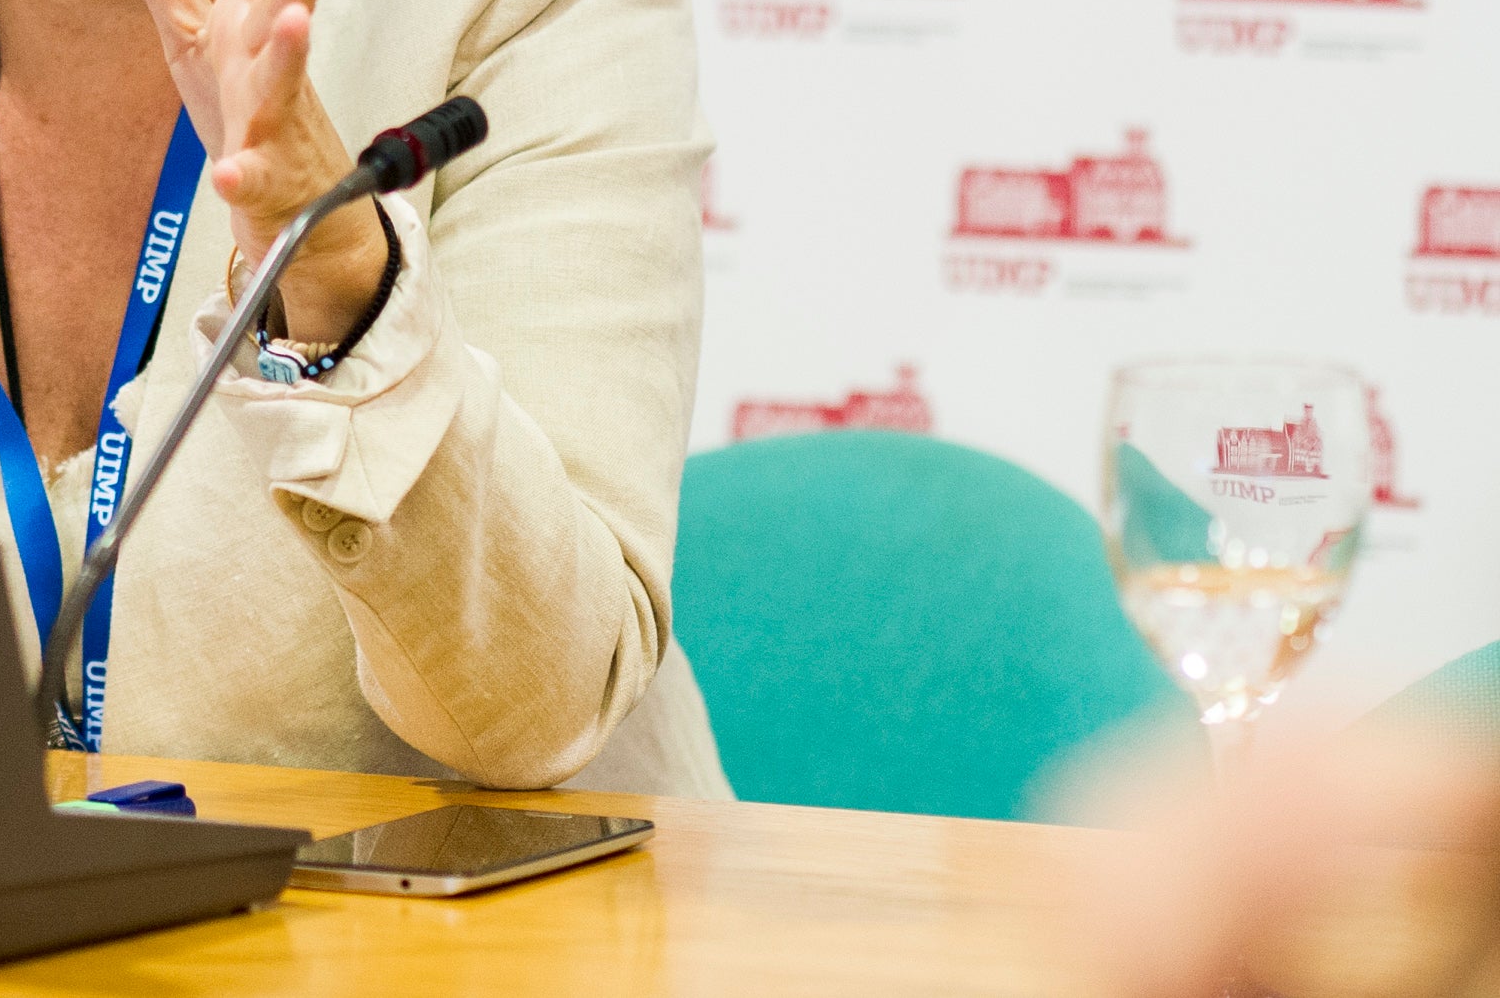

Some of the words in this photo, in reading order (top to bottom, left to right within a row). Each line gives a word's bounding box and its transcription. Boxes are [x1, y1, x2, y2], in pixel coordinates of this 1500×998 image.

[136, 208, 184, 304] UIMP
[91, 430, 128, 527] UIMP
[1211, 479, 1276, 504] UIMP
